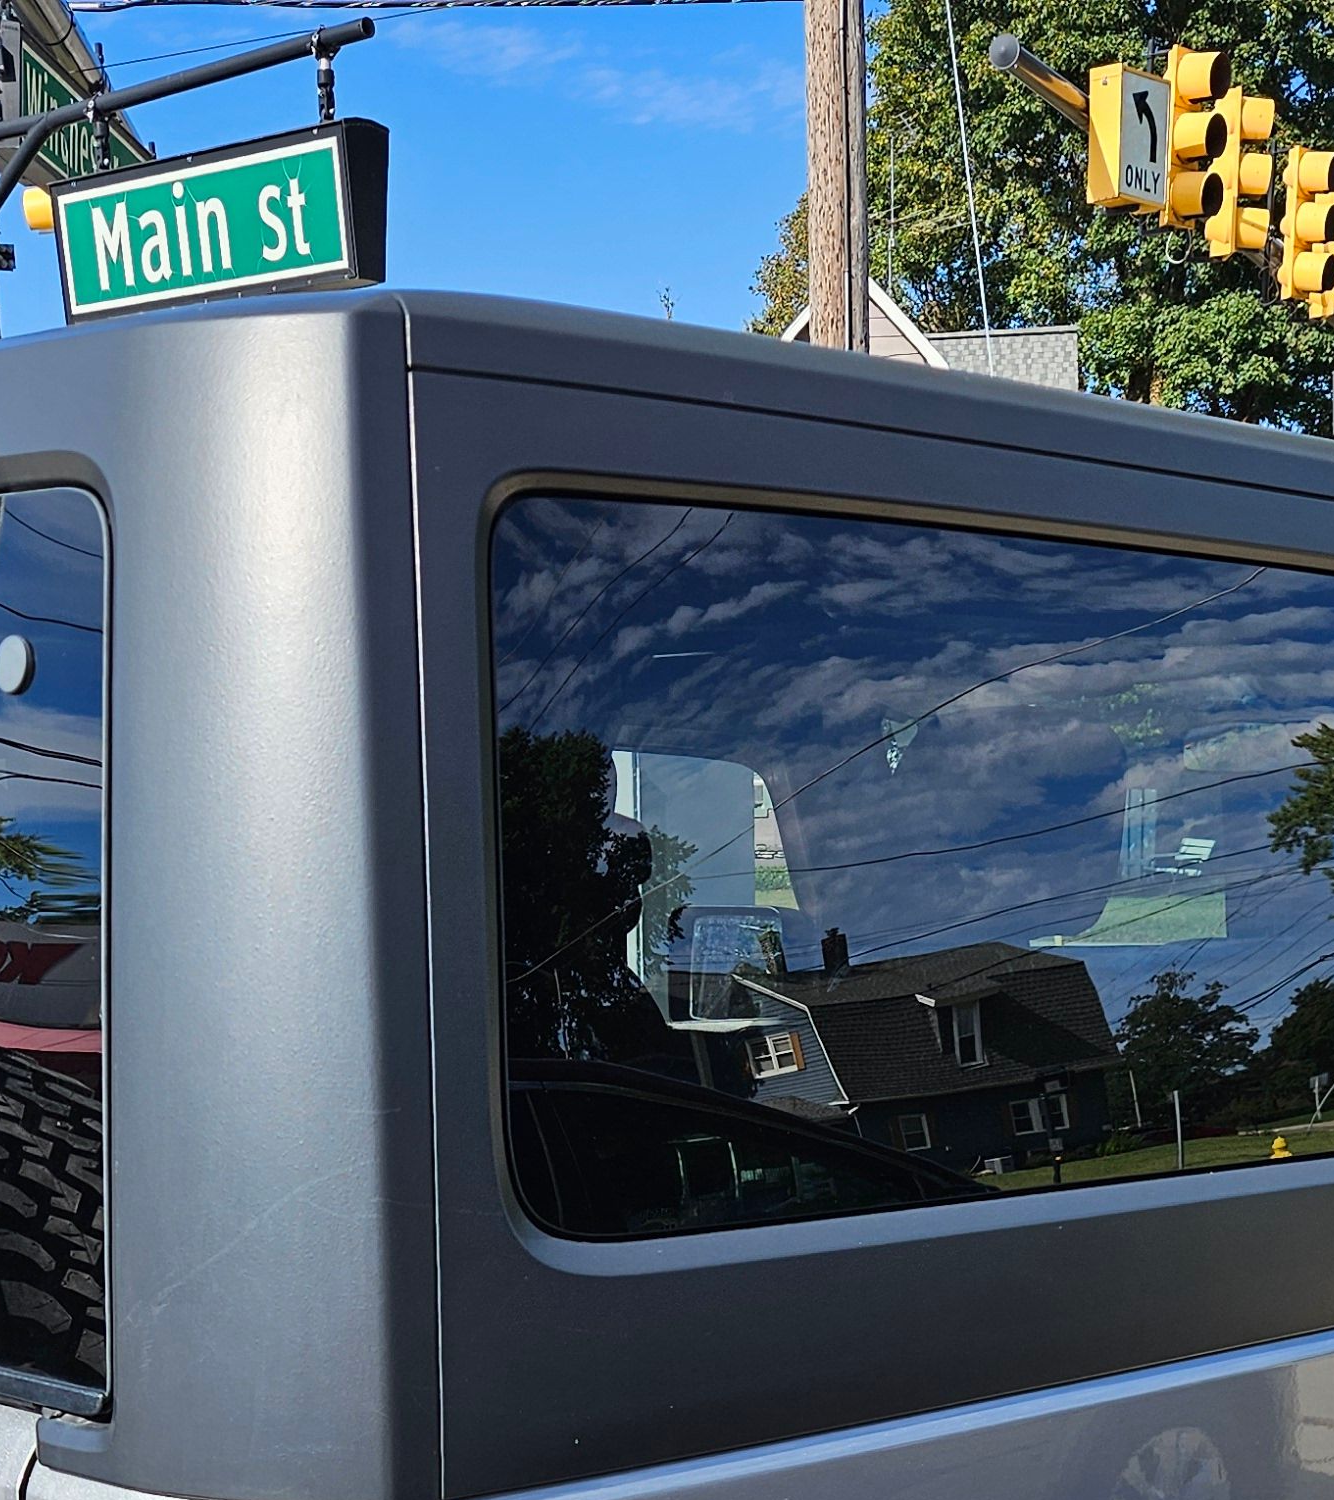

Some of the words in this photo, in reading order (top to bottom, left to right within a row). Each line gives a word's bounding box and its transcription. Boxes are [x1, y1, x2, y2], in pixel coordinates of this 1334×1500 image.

[1124, 165, 1161, 196] ONLY
[90, 180, 234, 292] Main
[257, 177, 312, 264] St
